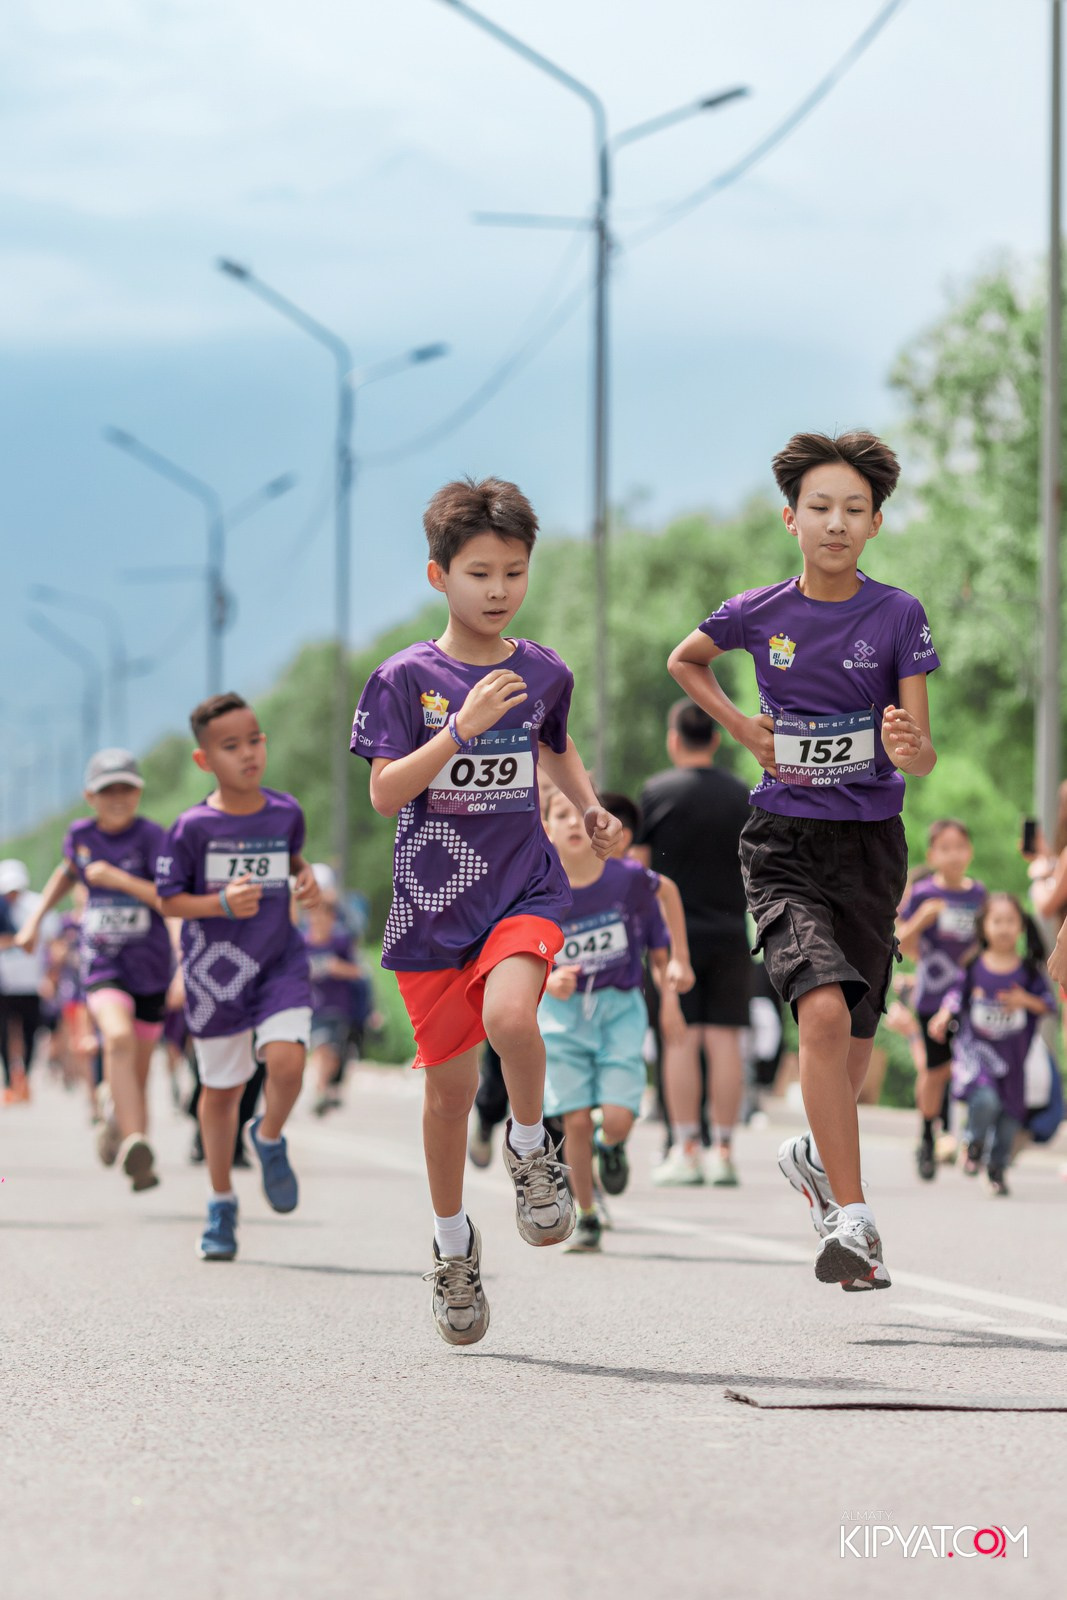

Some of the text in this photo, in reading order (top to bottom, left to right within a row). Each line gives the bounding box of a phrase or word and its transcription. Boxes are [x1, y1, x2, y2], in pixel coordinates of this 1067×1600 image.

[773, 658, 790, 666] RUN
[853, 661, 879, 669] GROUP
[426, 717, 443, 726] RUN
[358, 735, 374, 747] City
[799, 737, 853, 764] 152
[450, 757, 518, 788] 039
[780, 761, 871, 777] БАЛАЛАР ЖАРЫСЫ
[811, 777, 831, 785] 600
[431, 789, 529, 802] БАЛАЛАР ЖАРЫСЫ
[467, 802, 487, 812] 600
[228, 857, 270, 877] 138
[565, 931, 612, 959] 042
